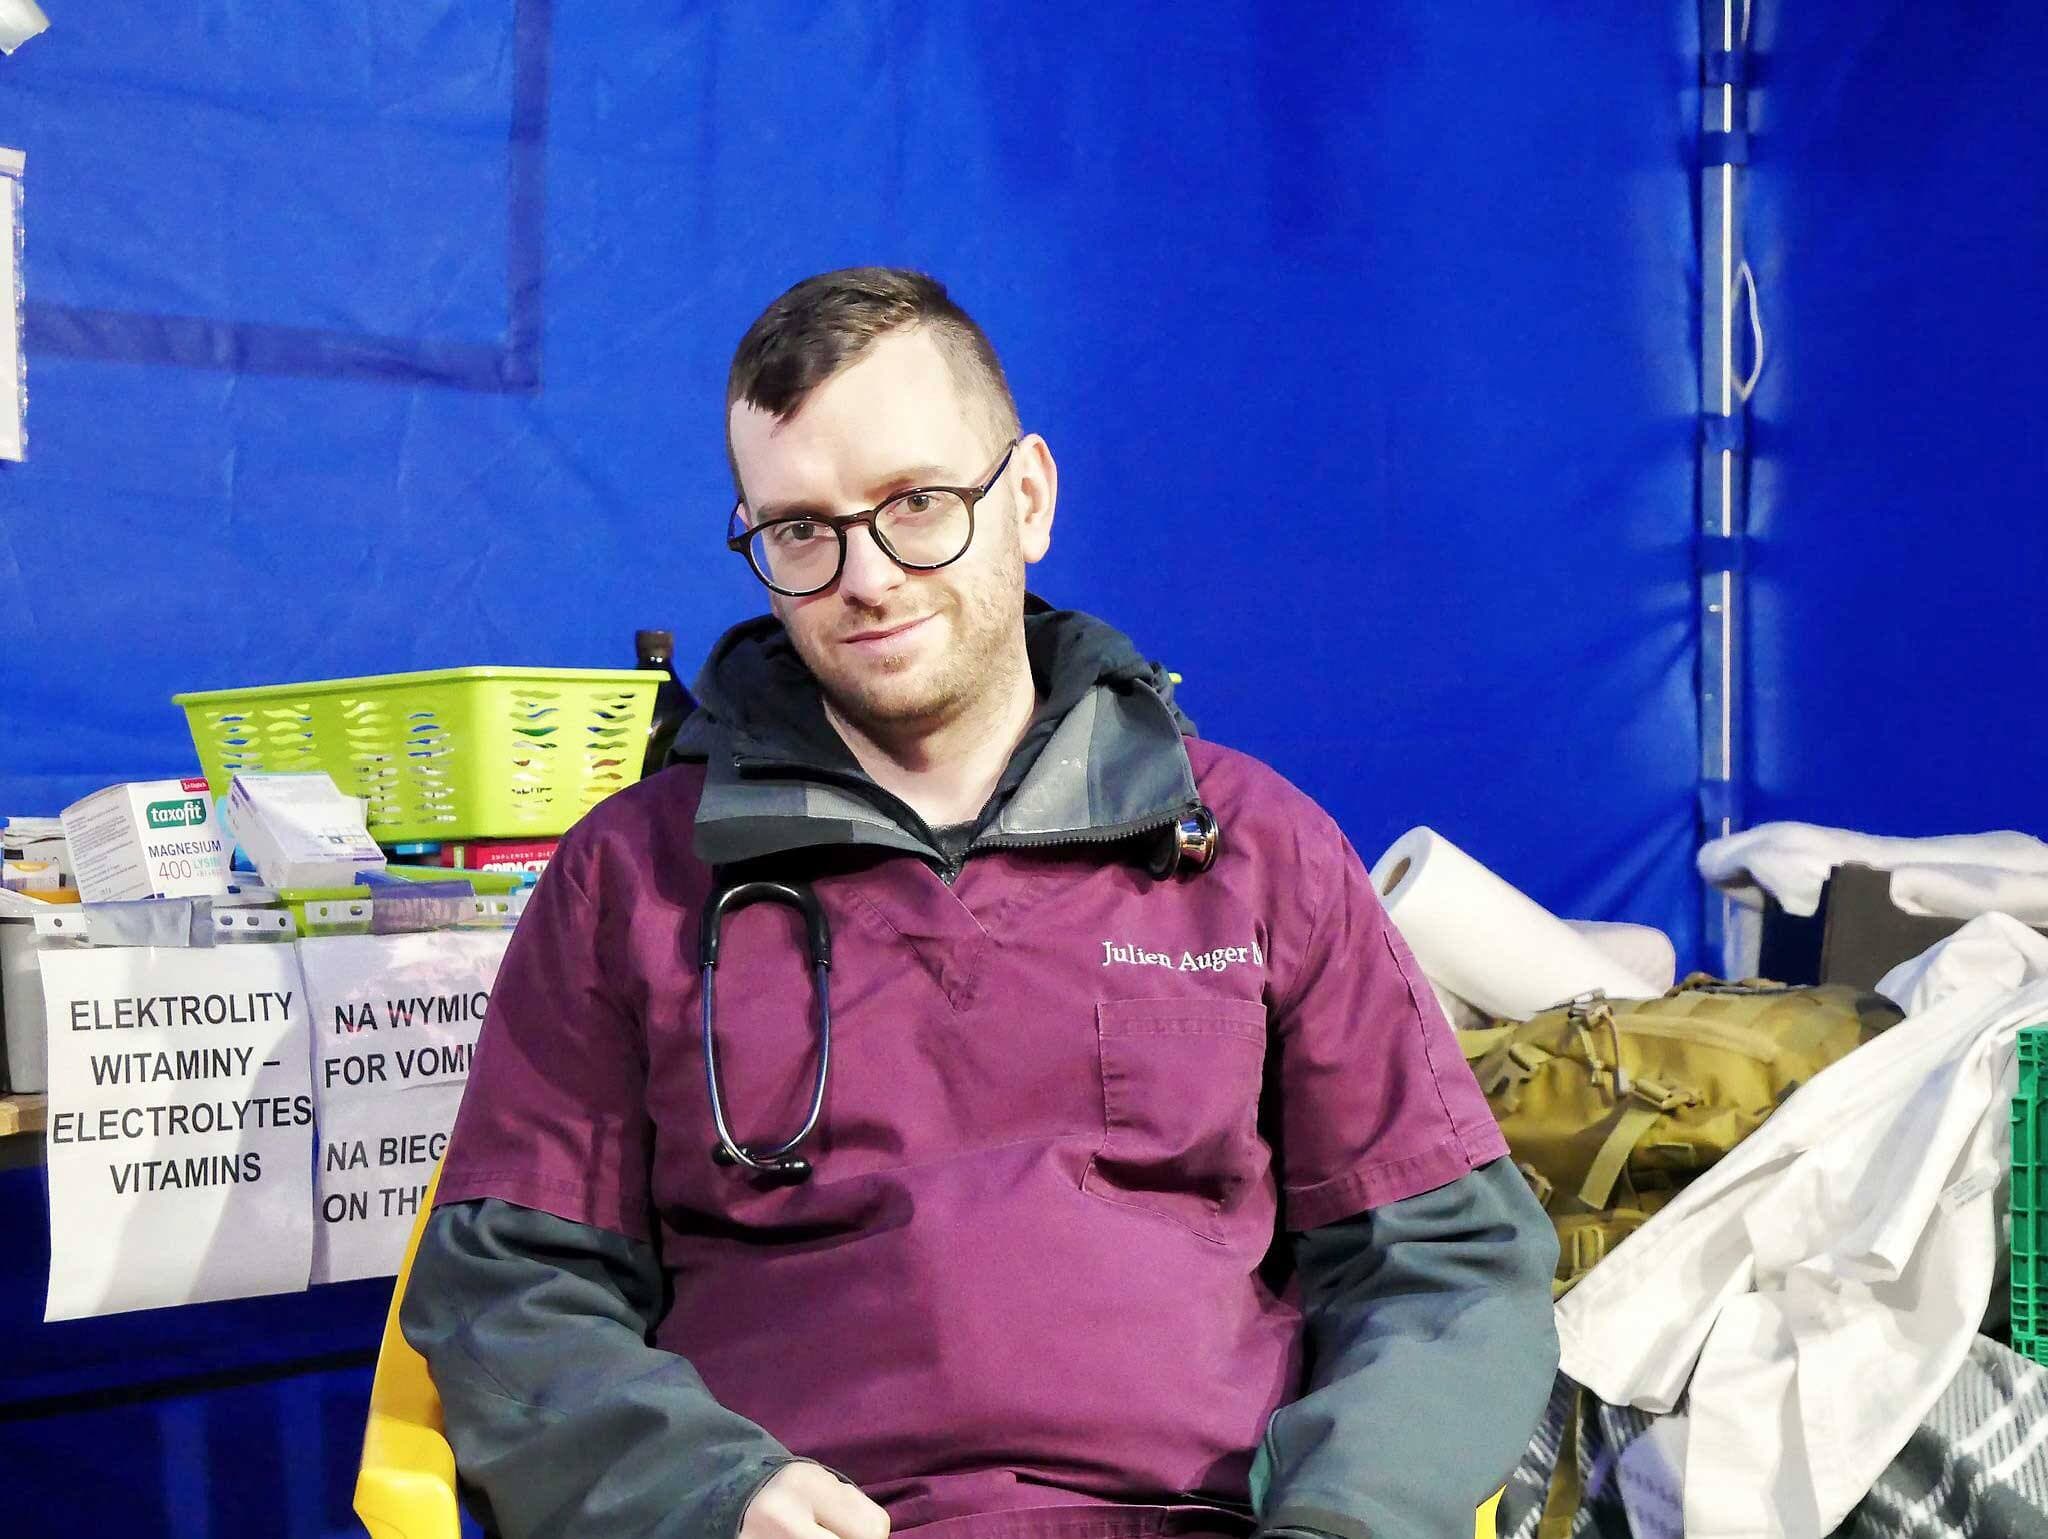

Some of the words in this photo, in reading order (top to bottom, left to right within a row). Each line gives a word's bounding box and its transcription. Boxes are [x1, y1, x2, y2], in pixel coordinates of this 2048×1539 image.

[151, 801, 201, 826] taxofit
[148, 840, 222, 858] MAGNESIUM
[159, 860, 191, 880] 400
[1103, 941, 1174, 969] Julien
[1179, 946, 1248, 972] Auger
[71, 992, 292, 1032] ELEKTROLITY
[335, 1003, 378, 1034] NA
[91, 1047, 253, 1086] WITAMINY
[325, 1053, 387, 1088] FOR
[396, 1043, 477, 1079] VOMI
[52, 1095, 312, 1143] ELECTROLYTES
[326, 1140, 369, 1171] NA
[110, 1152, 261, 1194] VITAMINS
[322, 1191, 367, 1223] ON
